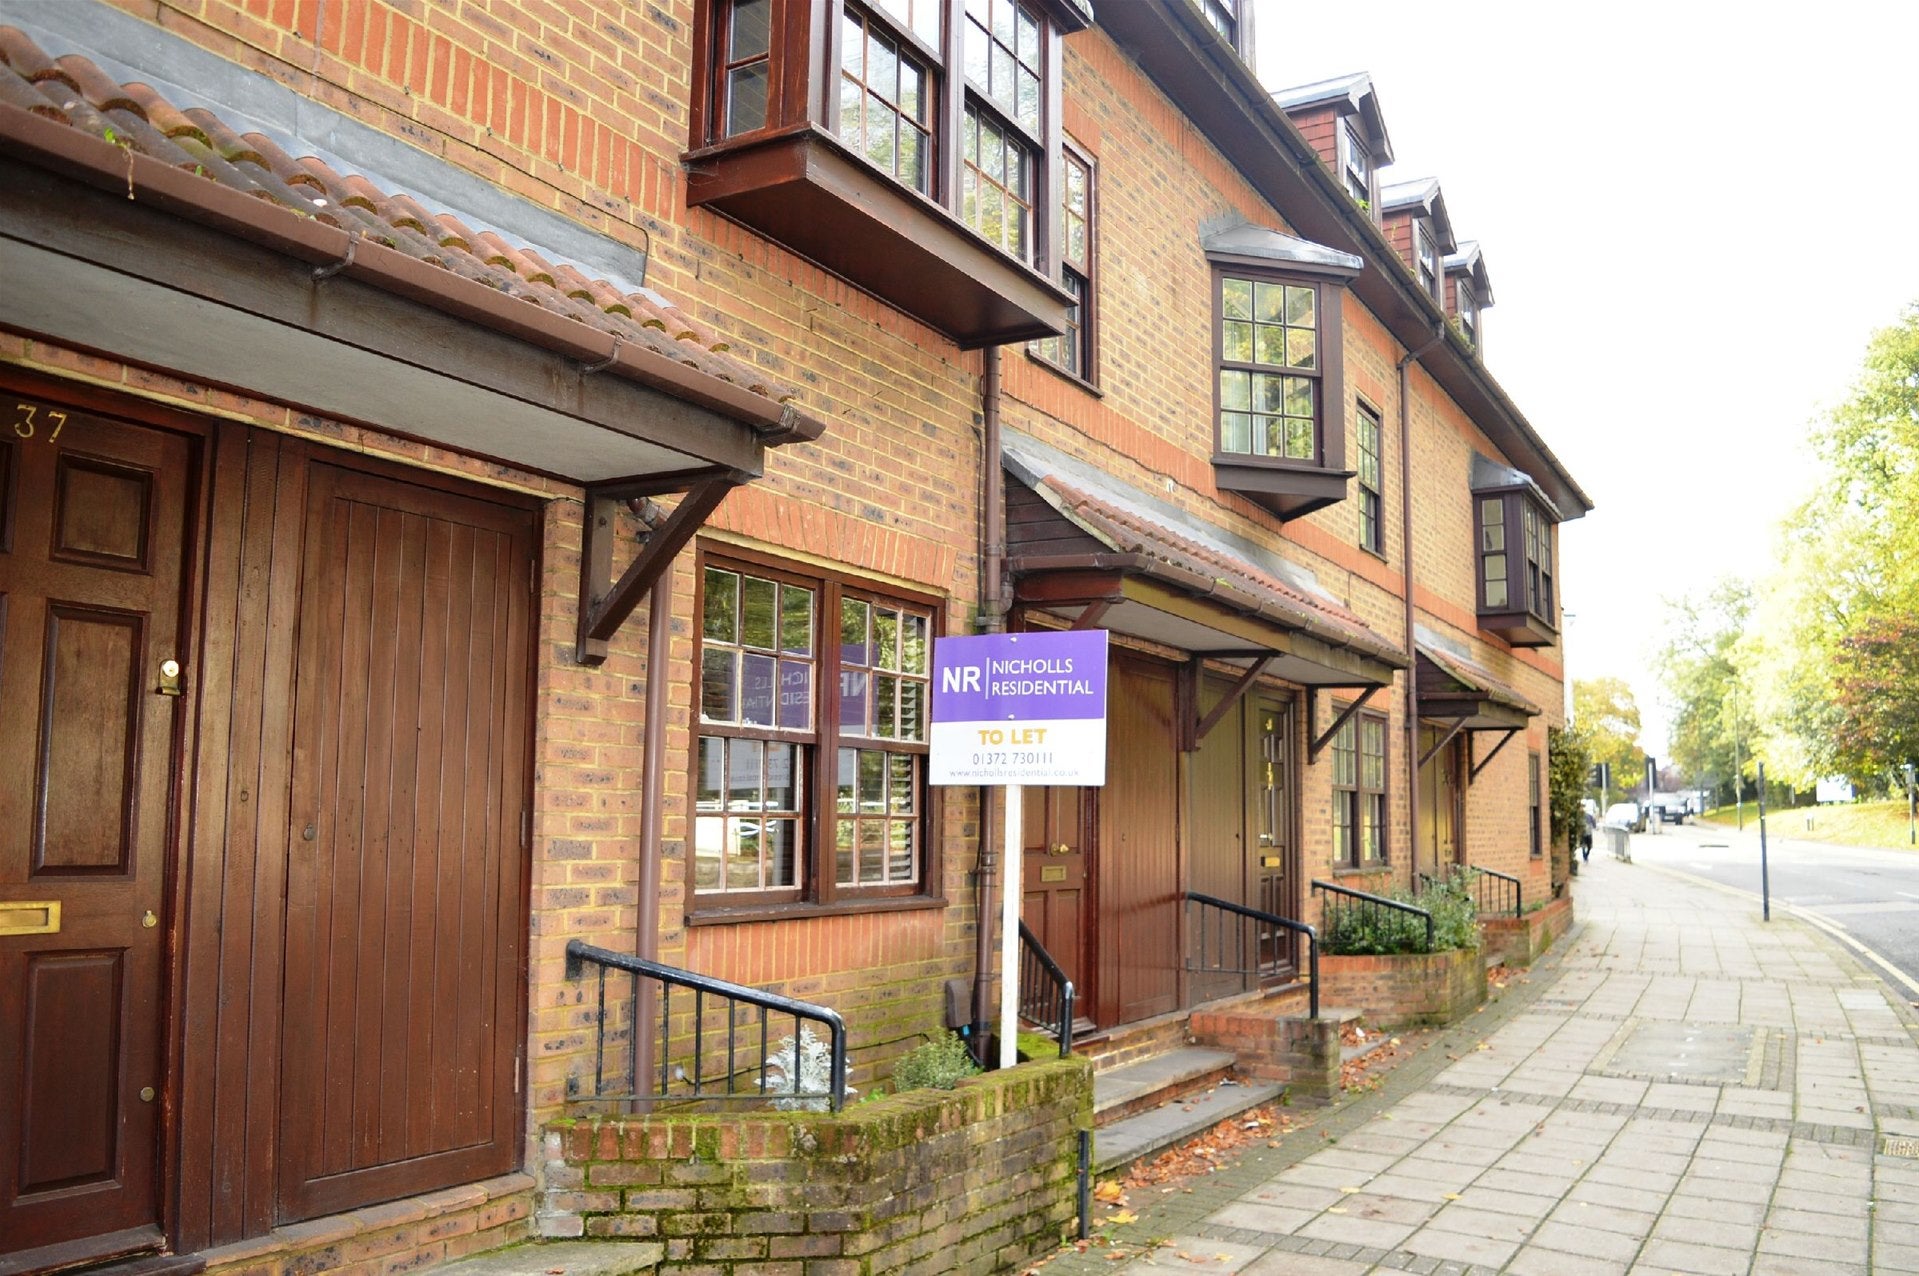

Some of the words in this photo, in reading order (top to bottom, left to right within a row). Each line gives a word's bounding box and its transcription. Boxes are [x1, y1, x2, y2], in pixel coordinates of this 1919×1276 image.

[14, 404, 68, 443] 37
[992, 658, 1073, 675] NICHOLLS
[942, 666, 981, 694] NR
[991, 679, 1094, 696] RESIDENTIAL
[978, 729, 1004, 746] TO
[1010, 728, 1048, 745] LET
[972, 752, 1007, 765] 01372
[1012, 752, 1053, 765] 730111
